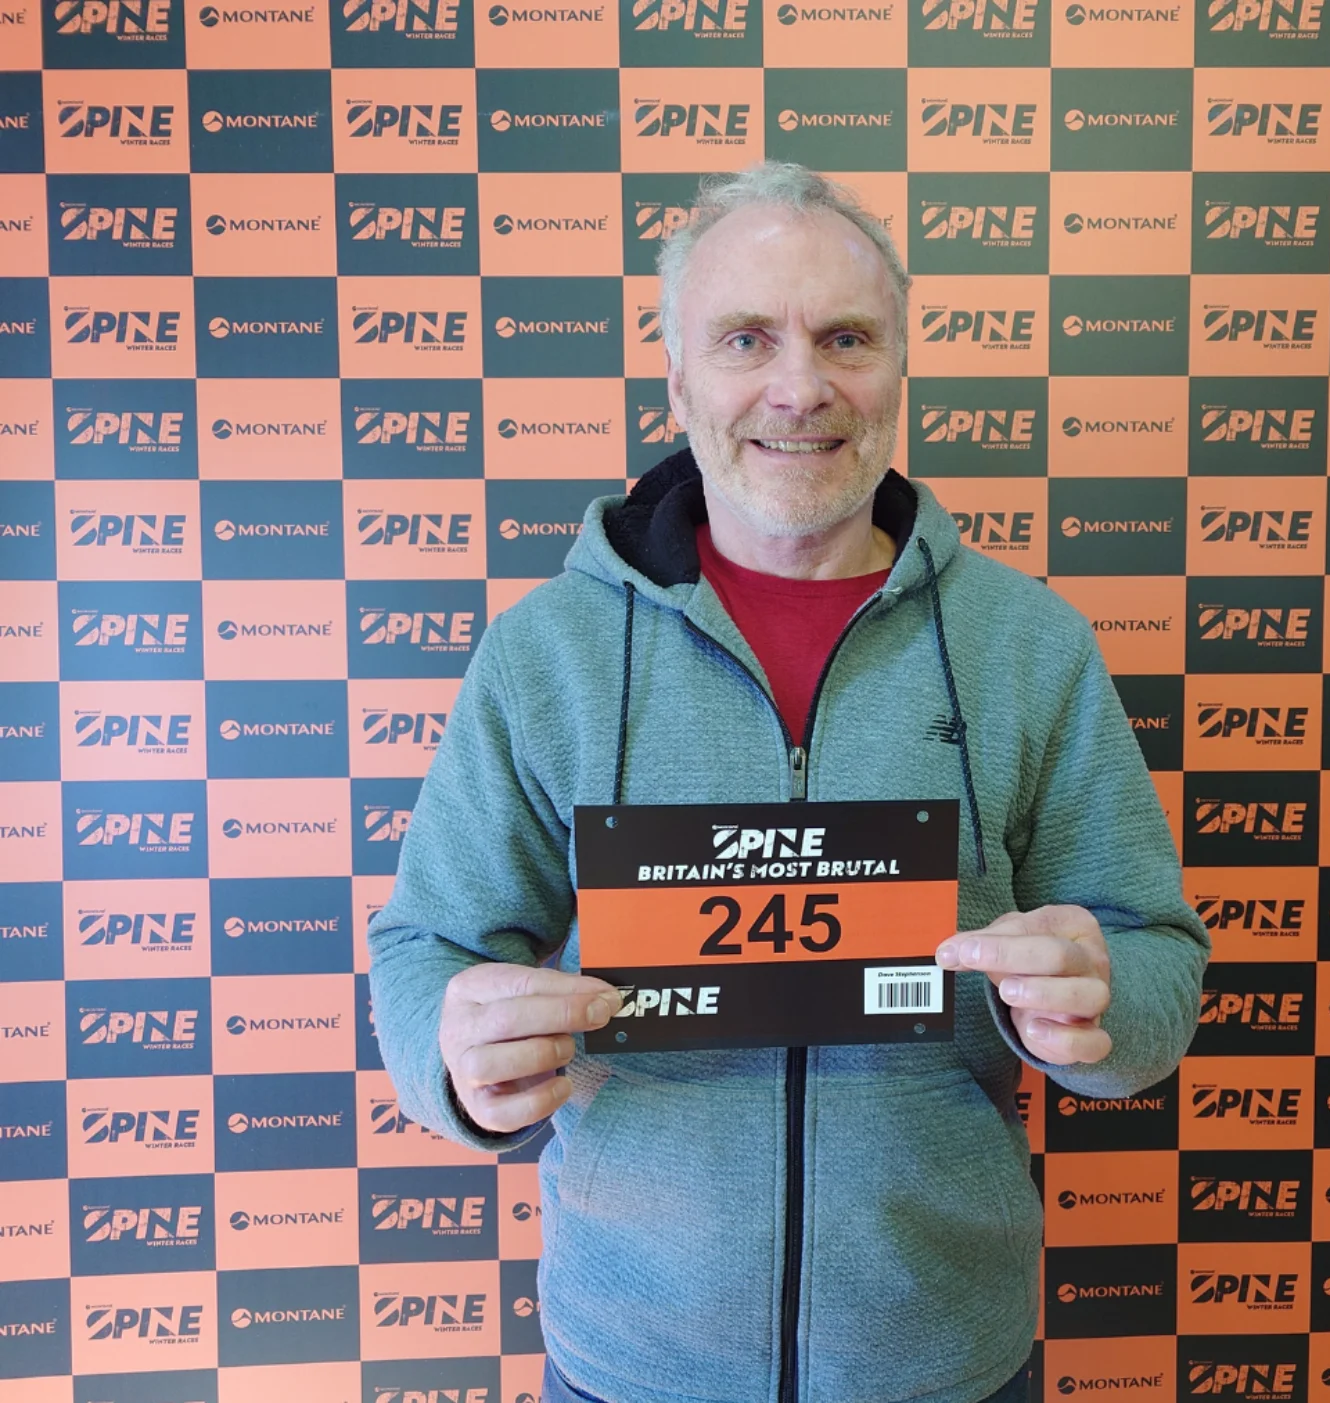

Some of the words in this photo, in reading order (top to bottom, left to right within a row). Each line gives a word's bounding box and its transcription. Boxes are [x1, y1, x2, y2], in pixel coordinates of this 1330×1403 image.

[54, 0, 171, 34] SPINE
[222, 10, 313, 23] MONTANE
[343, 0, 460, 32] SPINE
[512, 9, 603, 22] MONTANE
[632, 0, 749, 31] SPINE
[801, 8, 891, 21] MONTANE
[922, 0, 1039, 30] SPINE
[1089, 9, 1179, 22] MONTANE
[1207, 0, 1325, 32] SPINE
[58, 105, 174, 138] SPINE
[226, 115, 317, 128] MONTANE
[347, 104, 463, 138] SPINE
[514, 114, 605, 127] MONTANE
[635, 104, 750, 137] SPINE
[801, 114, 892, 127] MONTANE
[921, 103, 1037, 137] SPINE
[1087, 114, 1176, 126] MONTANE
[1207, 103, 1322, 136] SPINE
[60, 207, 178, 241] SPINE
[229, 219, 320, 231] MONTANE
[349, 207, 466, 240] SPINE
[517, 218, 607, 231] MONTANE
[921, 206, 1037, 239] SPINE
[1087, 217, 1176, 230] MONTANE
[1204, 206, 1320, 239] SPINE
[64, 311, 181, 343] SPINE
[232, 321, 322, 334] MONTANE
[352, 311, 468, 344] SPINE
[518, 321, 608, 333] MONTANE
[921, 310, 1036, 342] SPINE
[1085, 319, 1174, 332] MONTANE
[1203, 309, 1317, 342] SPINE
[67, 412, 184, 445] SPINE
[235, 423, 326, 436] MONTANE
[355, 411, 470, 444] SPINE
[521, 422, 610, 435] MONTANE
[921, 410, 1036, 442] SPINE
[1085, 420, 1173, 433] MONTANE
[1201, 409, 1315, 442] SPINE
[70, 514, 186, 546] SPINE
[238, 524, 329, 536] MONTANE
[358, 513, 472, 545] SPINE
[951, 512, 1035, 543] PINE
[1083, 520, 1171, 533] MONTANE
[1200, 510, 1313, 542] SPINE
[72, 614, 189, 646] SPINE
[241, 624, 331, 637] MONTANE
[360, 612, 475, 644] SPINE
[1198, 608, 1311, 640] SPINE
[75, 714, 192, 747] SPINE
[243, 723, 333, 736] MONTANE
[363, 713, 447, 744] SPIN
[1197, 707, 1309, 738] SPINE
[76, 812, 195, 846] SPINE
[245, 822, 336, 834] MONTANE
[1195, 802, 1307, 834] SPINE
[712, 827, 826, 860] SPINE
[637, 863, 745, 882] BRITAIN'S
[750, 861, 812, 879] MOST
[816, 859, 900, 877] BRUTAL
[78, 912, 196, 946] SPINE
[247, 919, 338, 933] MONTANE
[699, 893, 842, 956] 245
[1195, 900, 1305, 930] SPINE
[249, 1017, 340, 1031] MONTANE
[1196, 993, 1303, 1024] SPINE
[1, 1024, 50, 1038] TANE
[79, 1010, 198, 1044] SPINE
[1080, 1098, 1164, 1112] MONTANE
[1192, 1088, 1302, 1118] SPINE
[0, 1124, 51, 1139] TANE
[82, 1109, 200, 1144] SPINE
[251, 1114, 341, 1129] MONTANE
[1079, 1191, 1163, 1205] MONTANE
[1191, 1180, 1300, 1210] SPINE
[83, 1206, 202, 1242] SPINE
[253, 1211, 343, 1226] MONTANE
[372, 1196, 486, 1230] SPINE
[0, 1223, 54, 1237] TANE
[1079, 1284, 1161, 1298] MONTANE
[1190, 1273, 1299, 1304] SPINE
[86, 1305, 203, 1340] SPINE
[254, 1308, 344, 1324] MONTANE
[374, 1293, 487, 1327] SPINE
[1079, 1376, 1162, 1390] MONTANE
[1188, 1363, 1297, 1394] SPINE
